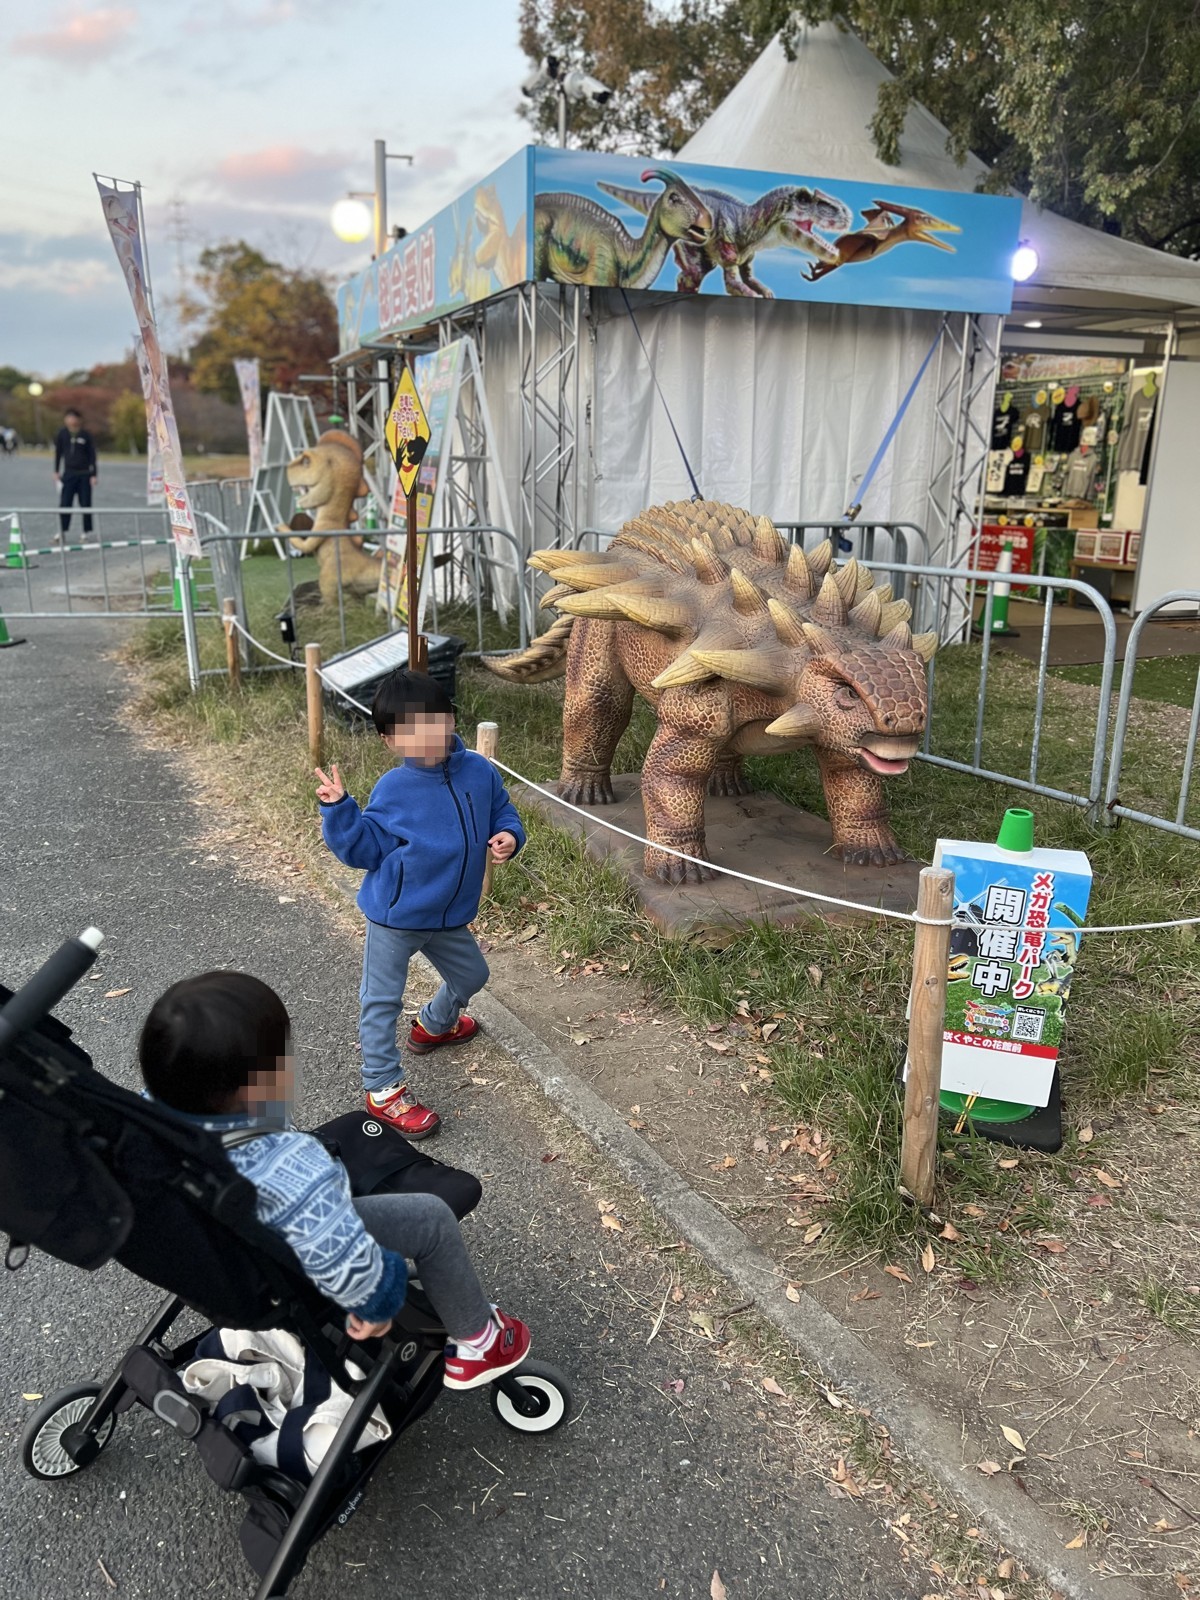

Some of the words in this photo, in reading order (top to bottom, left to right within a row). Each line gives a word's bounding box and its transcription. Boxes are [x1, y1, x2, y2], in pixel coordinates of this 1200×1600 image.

[972, 885, 1026, 996] 開催中
[1014, 872, 1052, 998] メガ恐竜パーク
[942, 1030, 1023, 1054] 咲くやこの花館前
[345, 1491, 363, 1515] cybex
